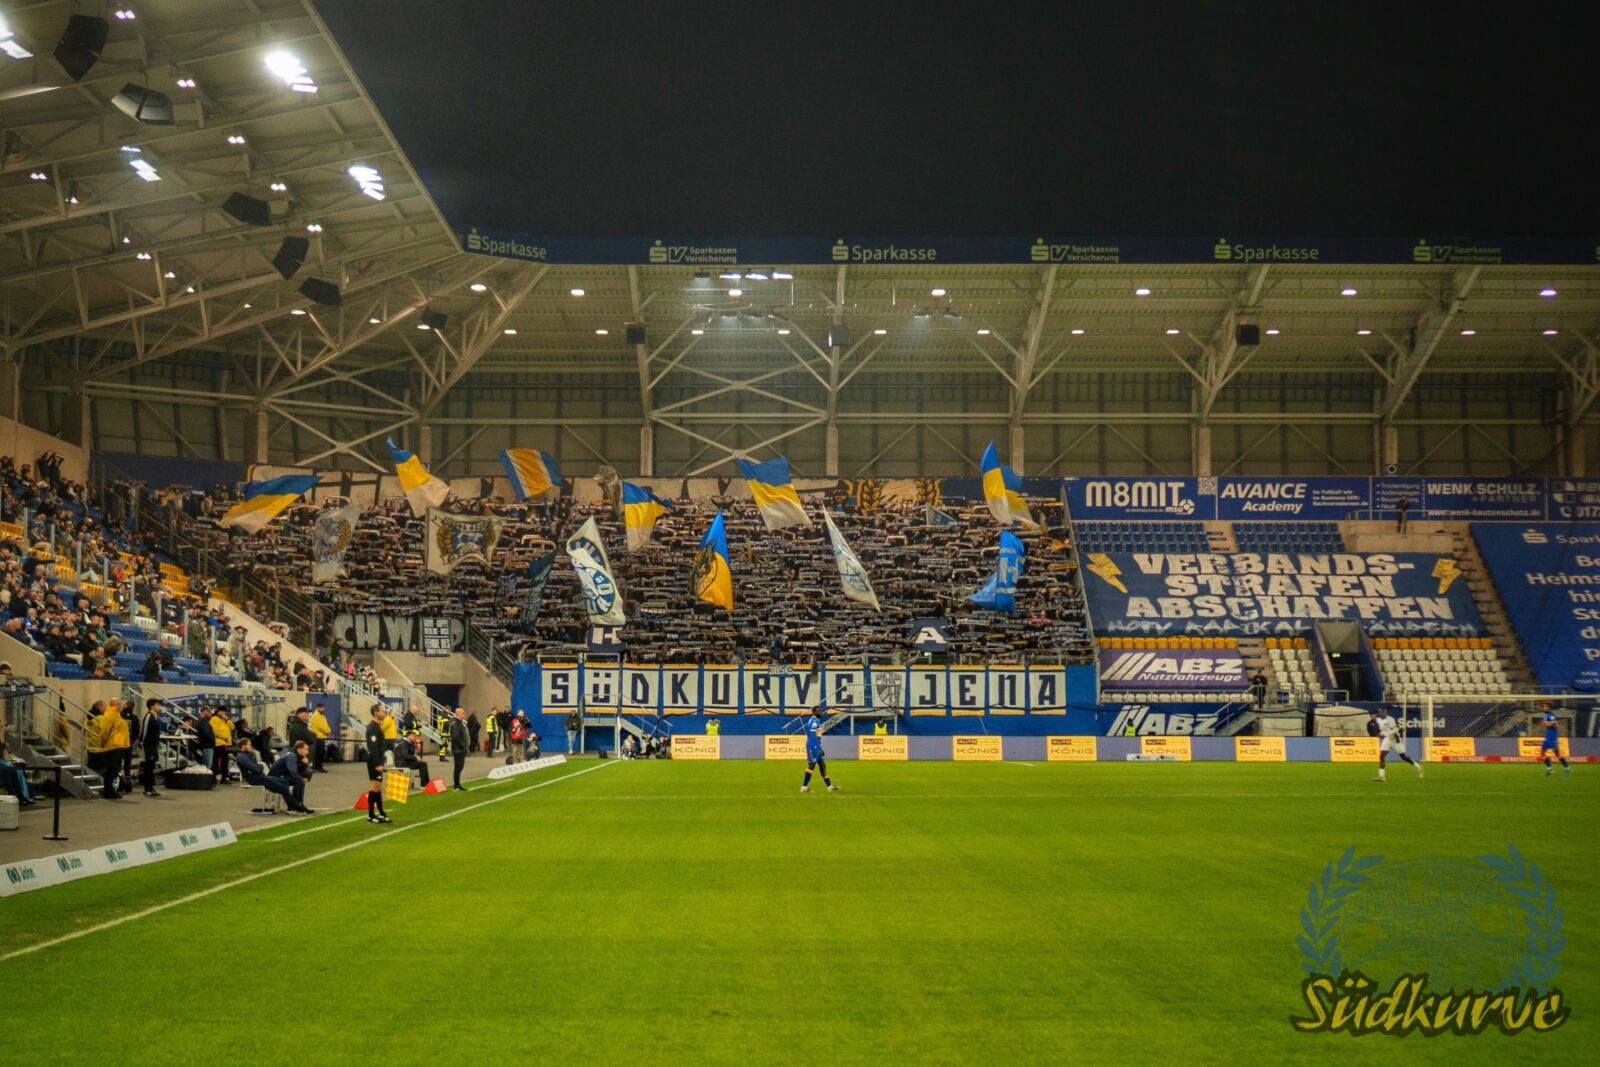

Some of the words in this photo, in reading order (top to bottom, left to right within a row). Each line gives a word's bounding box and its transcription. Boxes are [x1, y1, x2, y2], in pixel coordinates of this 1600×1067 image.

[482, 236, 547, 259] Sparkasse
[690, 247, 737, 255] Sparkassen
[1071, 245, 1119, 254] Sparkassen
[1234, 244, 1319, 262] Sparkasse
[685, 255, 737, 264] Versicherung
[852, 245, 937, 263] Sparkasse
[1066, 254, 1119, 263] Versicherung
[1221, 483, 1307, 499] AVANCE
[1427, 483, 1473, 494] WENK
[1242, 501, 1303, 514] Academy
[1132, 553, 1415, 575] VERBANDS-
[1164, 575, 1397, 597] STRAFEN
[1126, 597, 1454, 620] ABSCHAFFEN
[1145, 658, 1243, 673] ABZ
[1138, 672, 1242, 683] Nutzfahrzeuge
[551, 671, 853, 705] SÜDKURVE
[919, 673, 1056, 706] JENA
[1138, 713, 1219, 736] ABZ
[674, 745, 717, 753] KÖNIG
[862, 746, 905, 754] KÖNIG
[956, 746, 999, 754] KÖNIG
[1050, 746, 1094, 754] KÖNIG
[1145, 747, 1188, 755] KÖNIG
[1240, 747, 1282, 755] KÖNIG
[1334, 747, 1378, 756] KÖNIG
